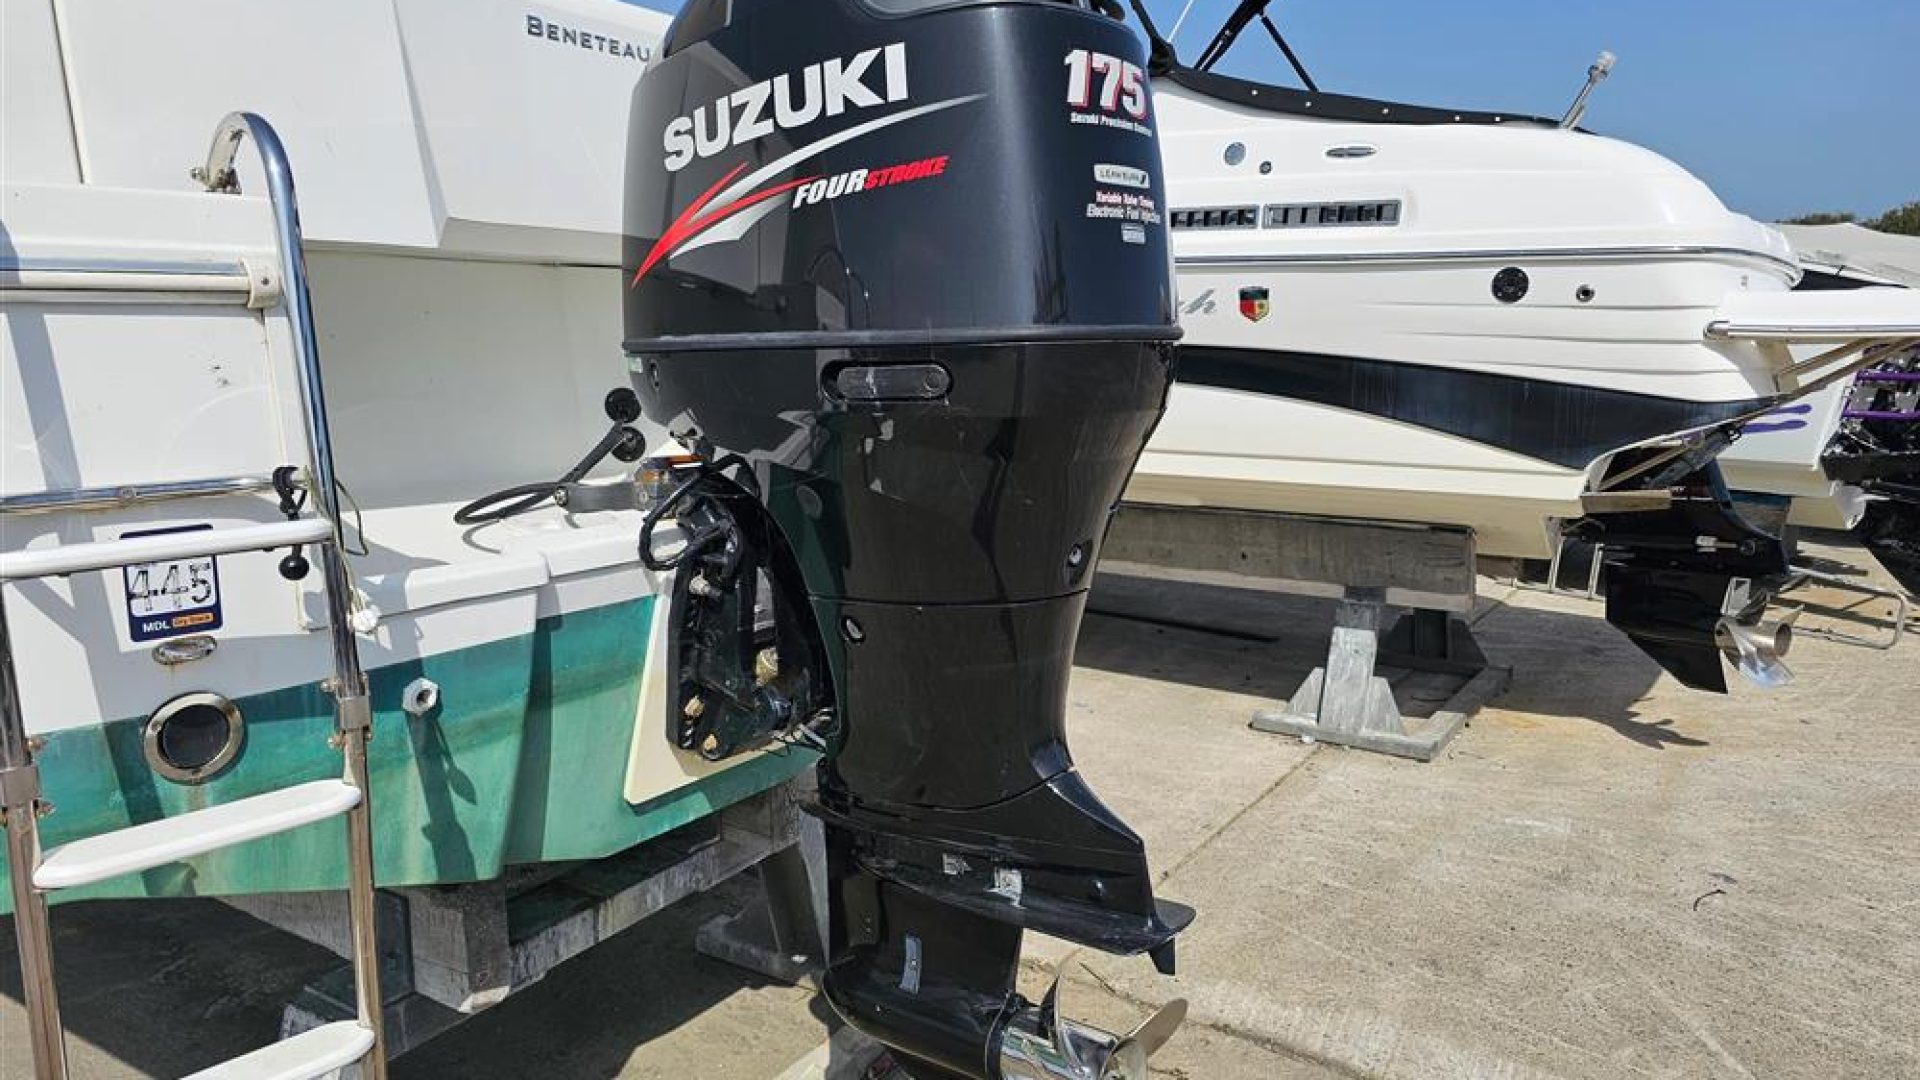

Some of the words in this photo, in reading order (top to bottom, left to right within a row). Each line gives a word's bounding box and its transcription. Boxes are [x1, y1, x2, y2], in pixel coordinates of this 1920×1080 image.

[526, 14, 651, 62] BENETEAU
[663, 42, 908, 172] SUZUKI
[1063, 49, 1147, 122] 175
[143, 622, 171, 633] MDL
